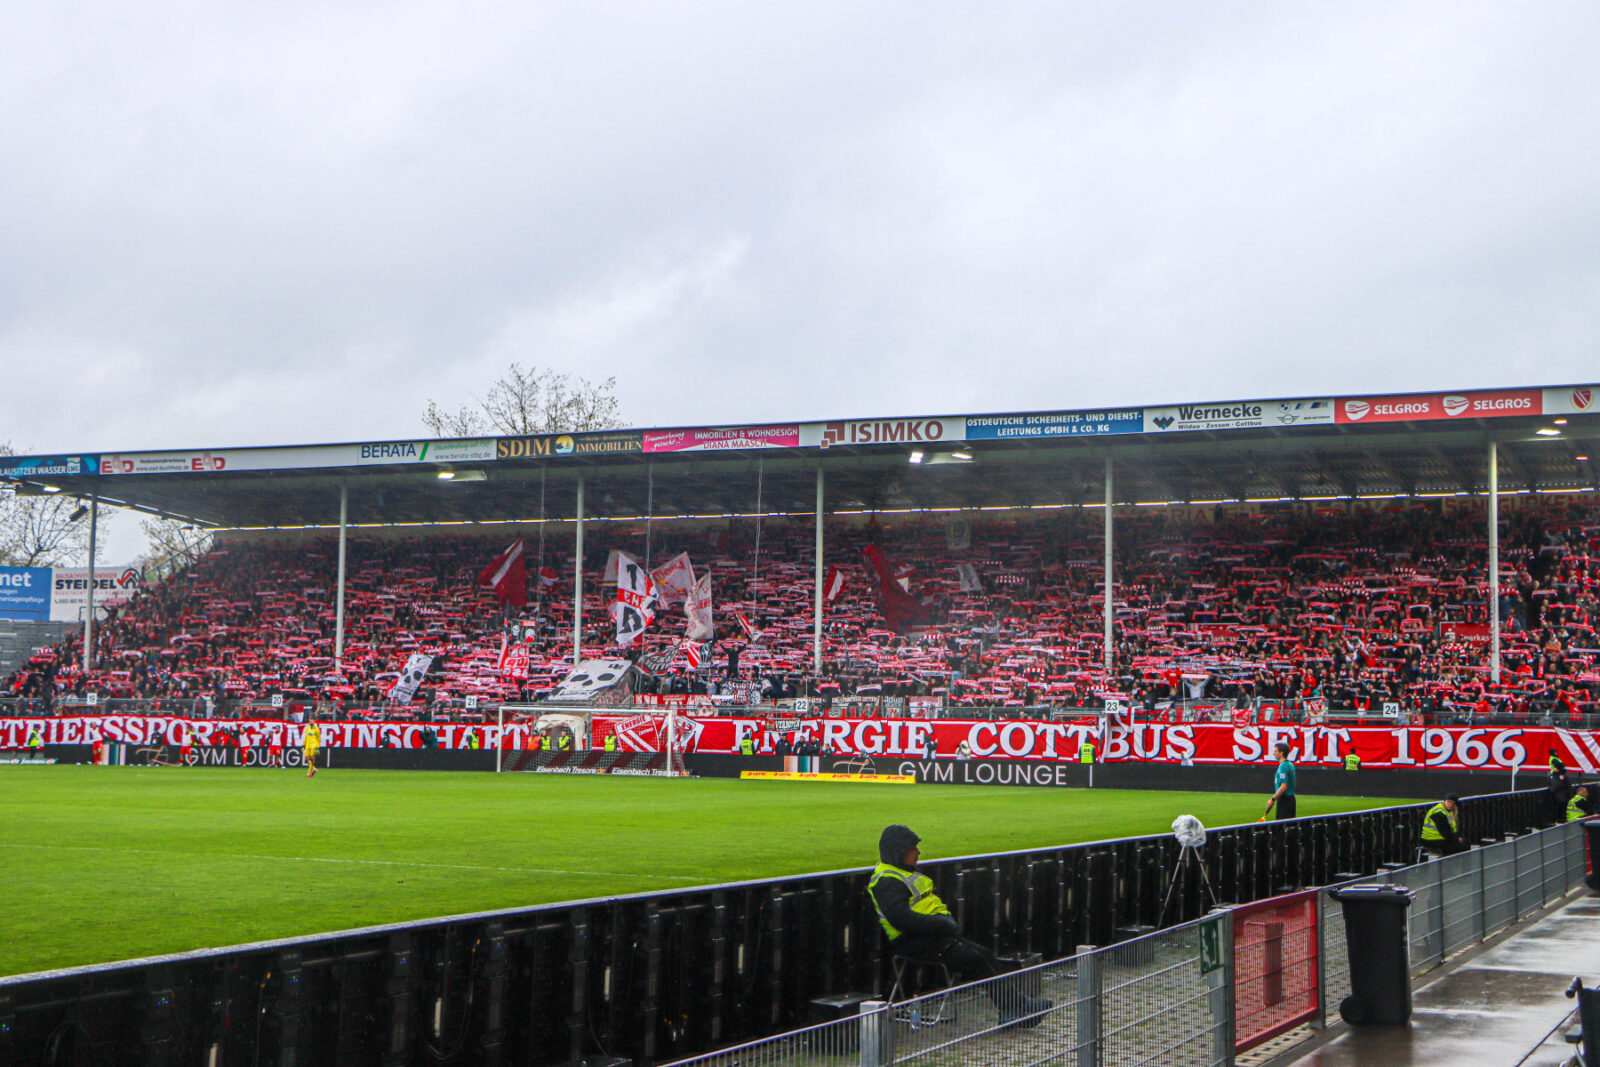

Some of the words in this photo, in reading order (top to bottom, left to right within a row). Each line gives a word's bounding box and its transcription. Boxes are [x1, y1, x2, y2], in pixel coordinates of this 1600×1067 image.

[1374, 403, 1430, 415] SELGROS
[1474, 398, 1531, 410] SELGROS
[1178, 404, 1262, 420] Wernecke
[967, 417, 1024, 427] OSTDEUTSCHE
[1026, 416, 1084, 425] SICHERHEITS-
[1086, 414, 1105, 422] UND
[1107, 412, 1142, 421] DIENST-
[695, 430, 738, 440] IMMOBILIEN
[739, 430, 745, 438] &
[747, 428, 798, 438] WOHNDESIGN
[851, 421, 943, 443] ISIMKO
[997, 427, 1042, 436] LEISTUNGS
[1044, 425, 1070, 434] GMBH
[1072, 425, 1078, 433] &
[1080, 424, 1095, 433] CO.
[1098, 424, 1110, 432] KG
[361, 443, 416, 458] BERATA
[497, 438, 551, 458] SDIM
[576, 441, 643, 453] IMMOBILIEN
[703, 440, 730, 449] DIANA
[0, 466, 38, 476] LAUSITZER
[38, 465, 67, 474] WASSER
[273, 695, 282, 705] 20
[467, 695, 476, 706] 21
[797, 700, 807, 710] 22
[1107, 701, 1118, 711] 23
[1385, 704, 1397, 716] 24
[967, 721, 1196, 760] COTTBUS
[1232, 725, 1352, 763] SEIT
[1391, 728, 1527, 767] 1966
[536, 766, 571, 774] Eisenbach
[612, 767, 650, 776] Eisenbach
[899, 761, 953, 782] GYM
[964, 763, 1067, 786] LOUNGE
